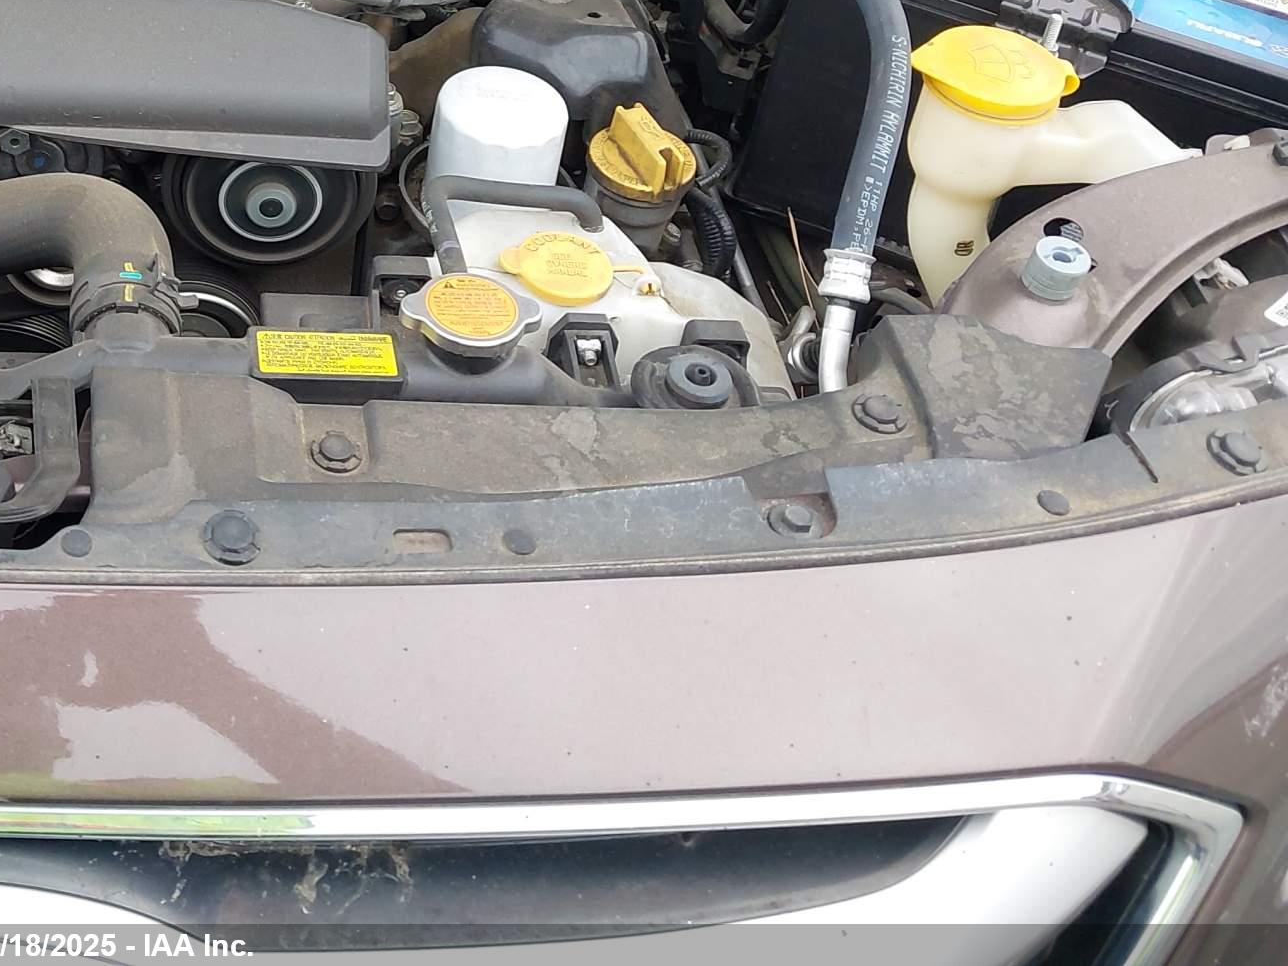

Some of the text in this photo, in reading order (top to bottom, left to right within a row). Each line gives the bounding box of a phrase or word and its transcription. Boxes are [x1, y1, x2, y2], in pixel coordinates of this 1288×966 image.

[887, 34, 907, 108] S-NICHIRIN
[870, 109, 901, 174] HYLAMMIT
[525, 233, 601, 255] COOLANT
